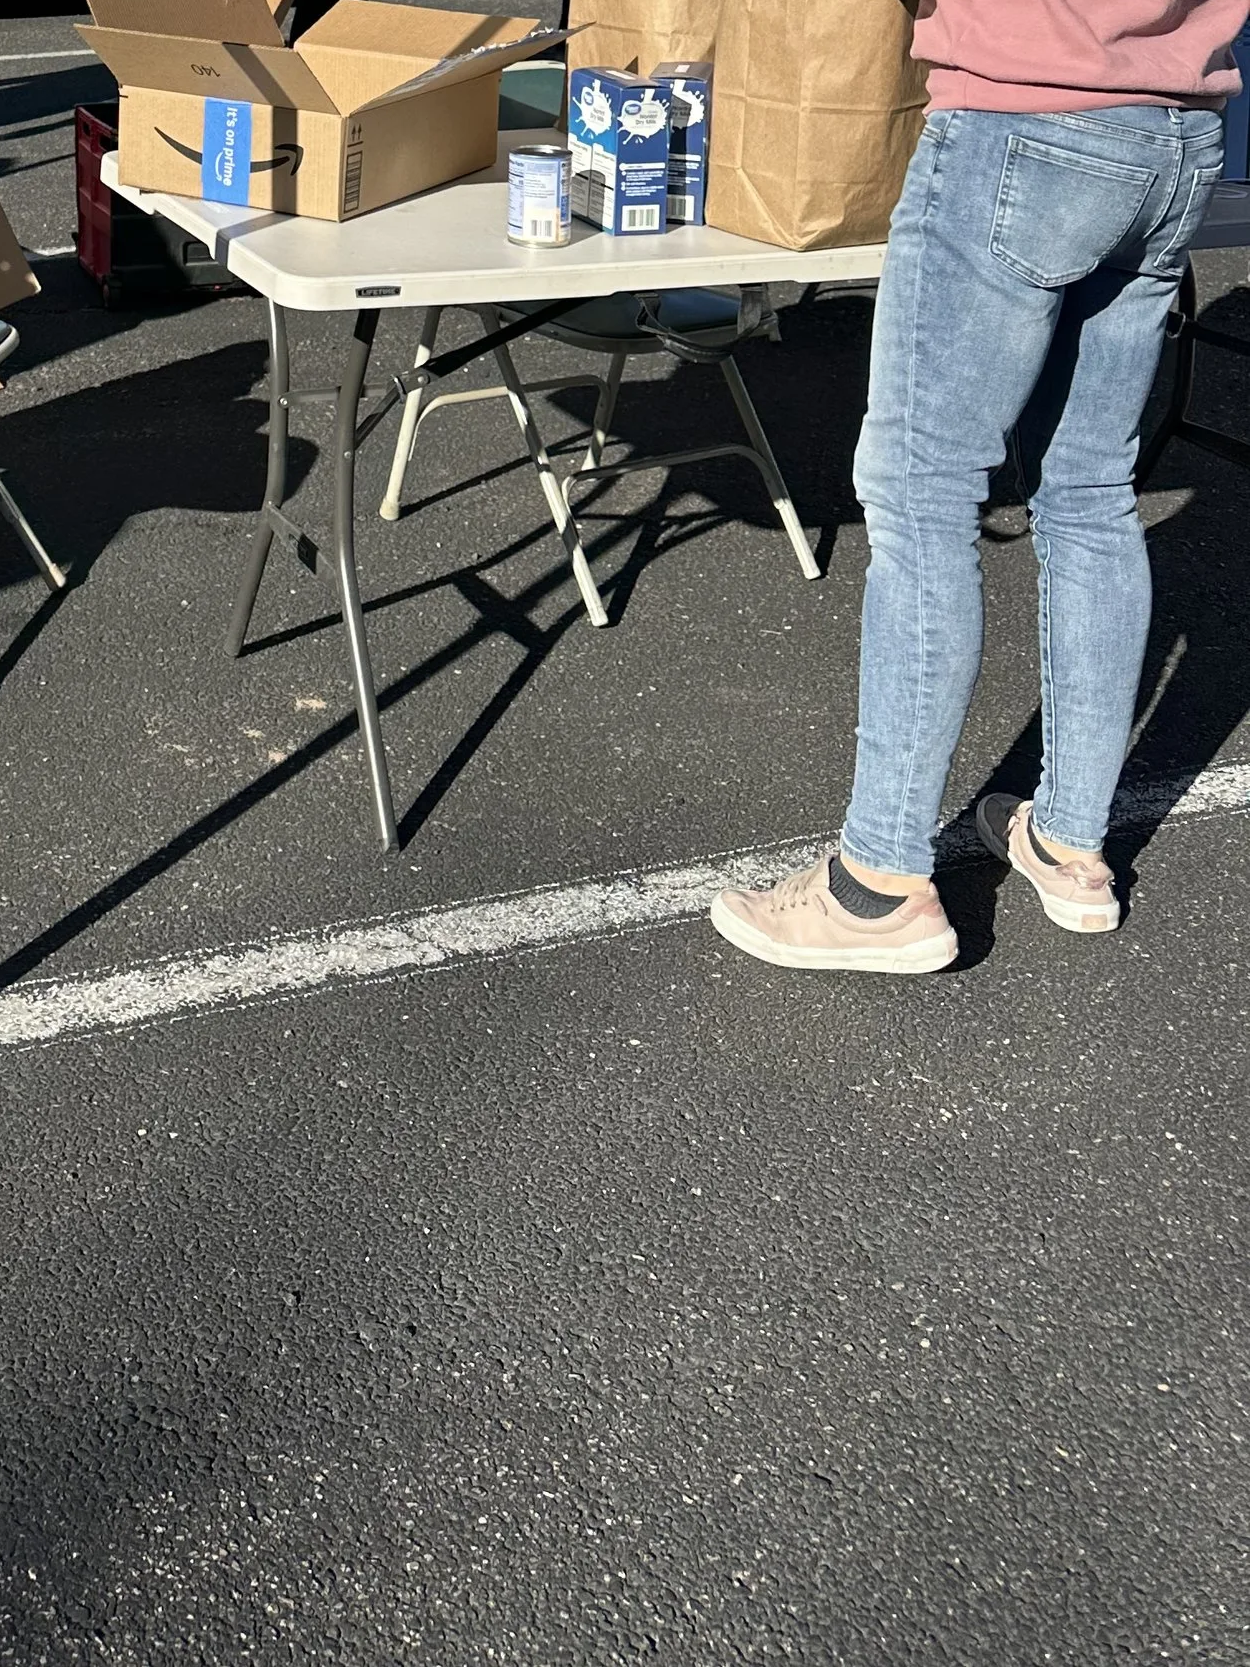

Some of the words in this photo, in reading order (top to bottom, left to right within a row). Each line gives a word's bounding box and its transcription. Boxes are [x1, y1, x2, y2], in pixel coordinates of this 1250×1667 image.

[226, 106, 238, 128] It's
[225, 129, 235, 146] on
[222, 147, 236, 187] prime
